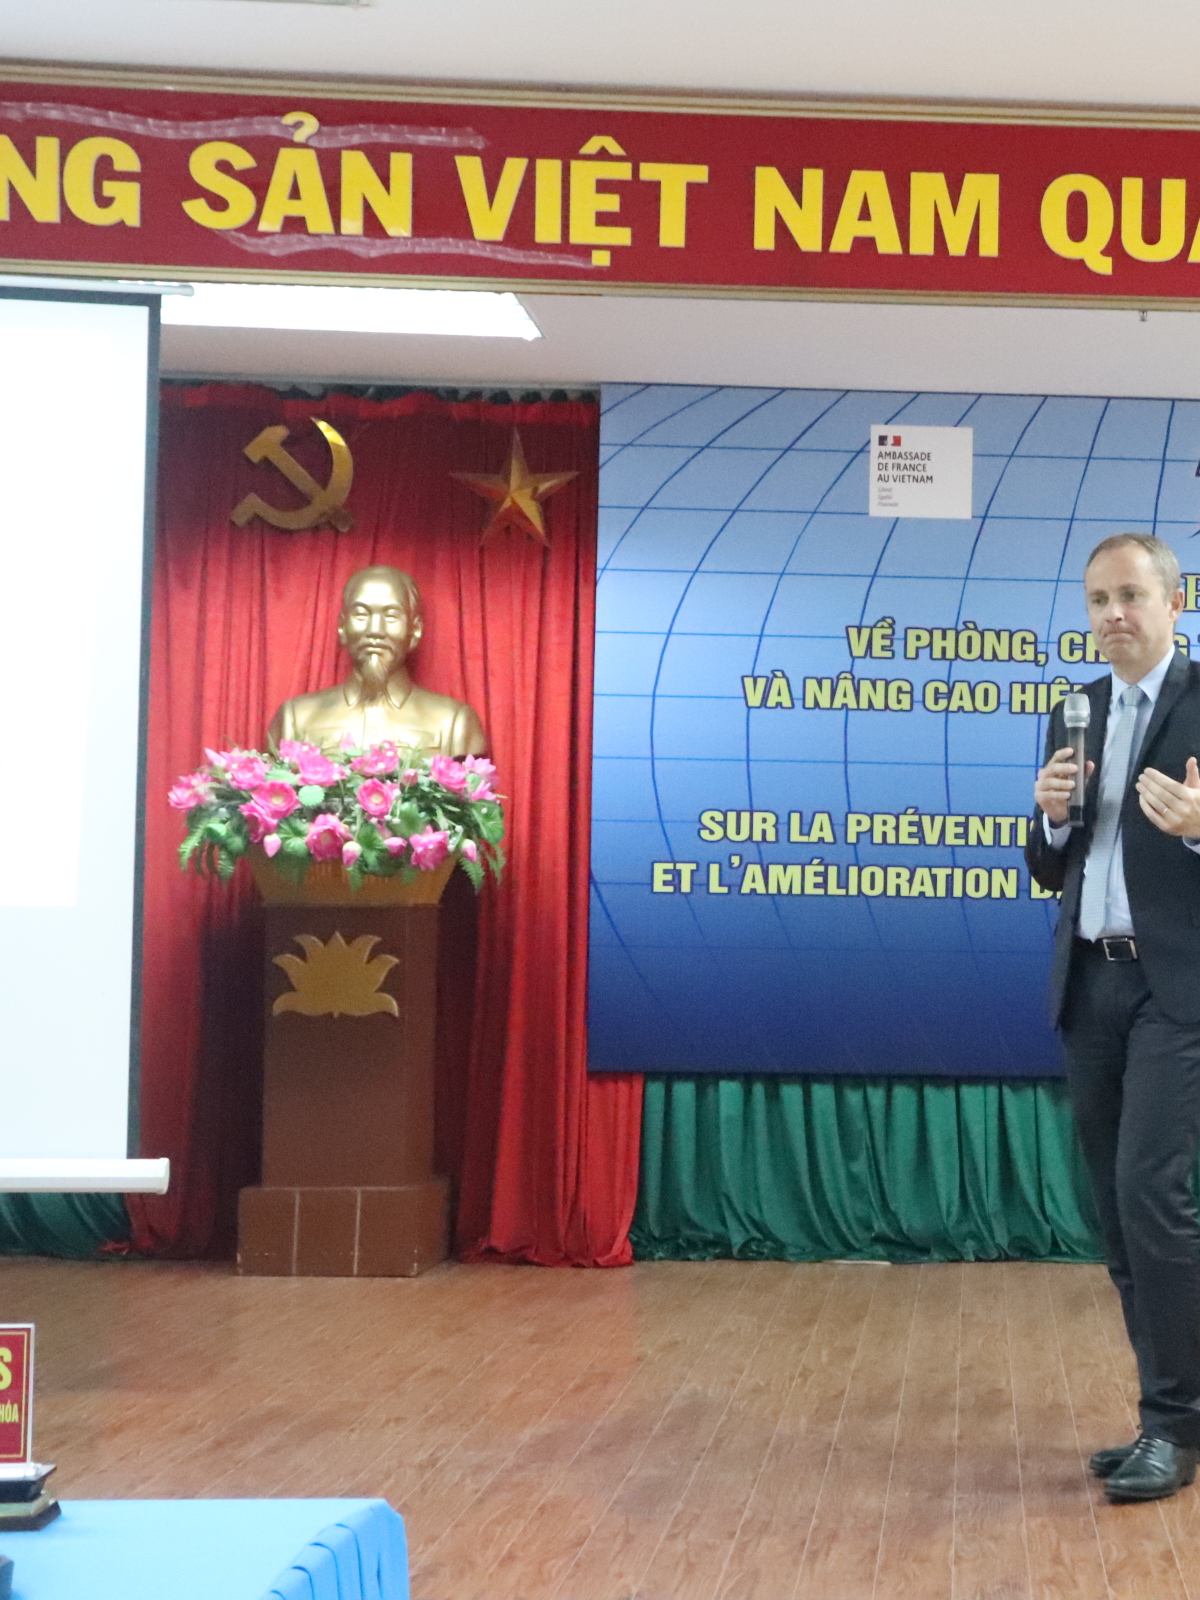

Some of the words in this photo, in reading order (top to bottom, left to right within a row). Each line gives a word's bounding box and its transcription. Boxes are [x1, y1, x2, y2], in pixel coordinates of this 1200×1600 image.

[0, 134, 141, 228] NG
[181, 111, 414, 239] SẢN
[456, 135, 709, 267] VIỆT
[754, 166, 1000, 257] NAM
[877, 451, 931, 460] AMBASSADE
[877, 462, 889, 471] DE
[891, 463, 927, 472] FRANCE
[877, 474, 889, 483] AU
[892, 475, 933, 484] VIETNAM
[847, 617, 895, 659] VỀ
[904, 619, 1049, 666] PHÒNG,
[741, 670, 793, 709] VÀ
[804, 671, 911, 712] NÂNG
[924, 680, 1000, 713] CAO
[698, 809, 777, 843] SUR
[788, 811, 834, 844] LA
[846, 807, 1034, 848] PRÉVENTI
[652, 861, 698, 895] ET
[708, 855, 1019, 900] L'AMÉLIORATION
